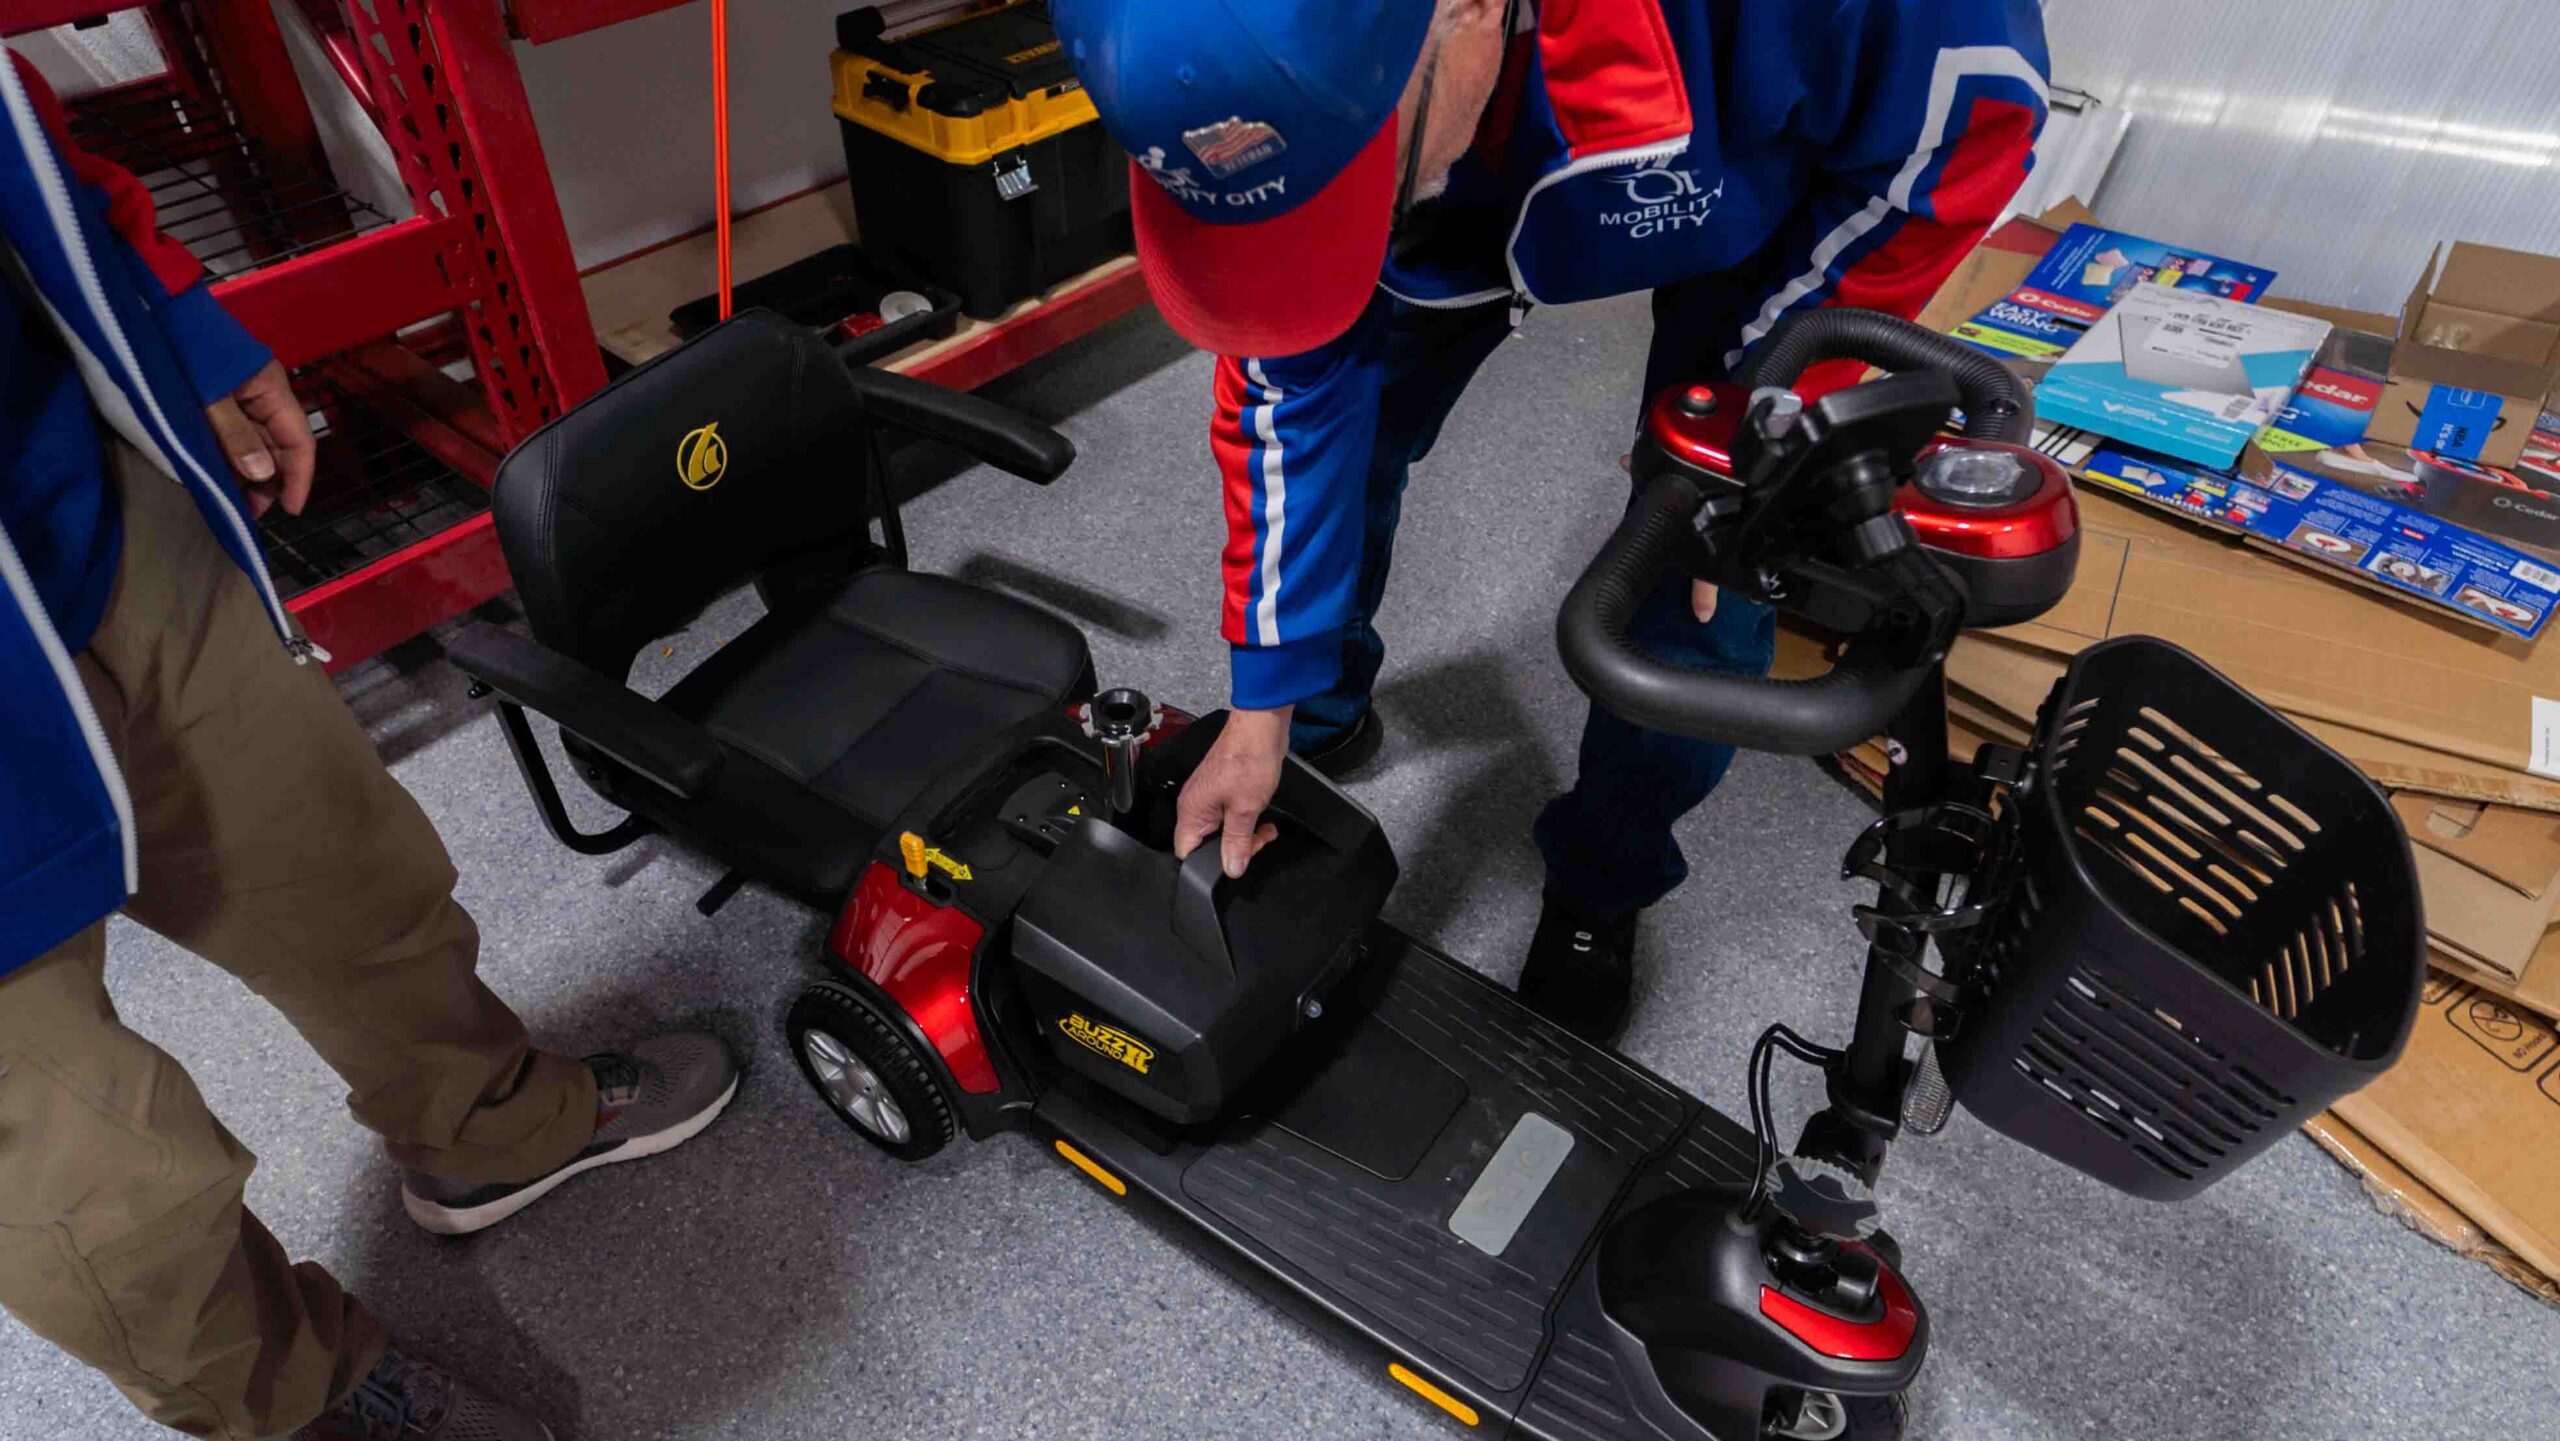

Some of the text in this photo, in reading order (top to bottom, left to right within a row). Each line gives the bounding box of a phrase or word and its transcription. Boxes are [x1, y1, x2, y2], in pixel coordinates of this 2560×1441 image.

[1226, 176, 1286, 206] CITY
[1600, 177, 1724, 225] MOBILITY
[1630, 208, 1711, 238] CITY
[2492, 497, 2560, 521] O-Cedar
[1068, 1026, 1122, 1060] AROUND
[1069, 1012, 1126, 1052] BUZZ
[1122, 1043, 1149, 1074] XL
